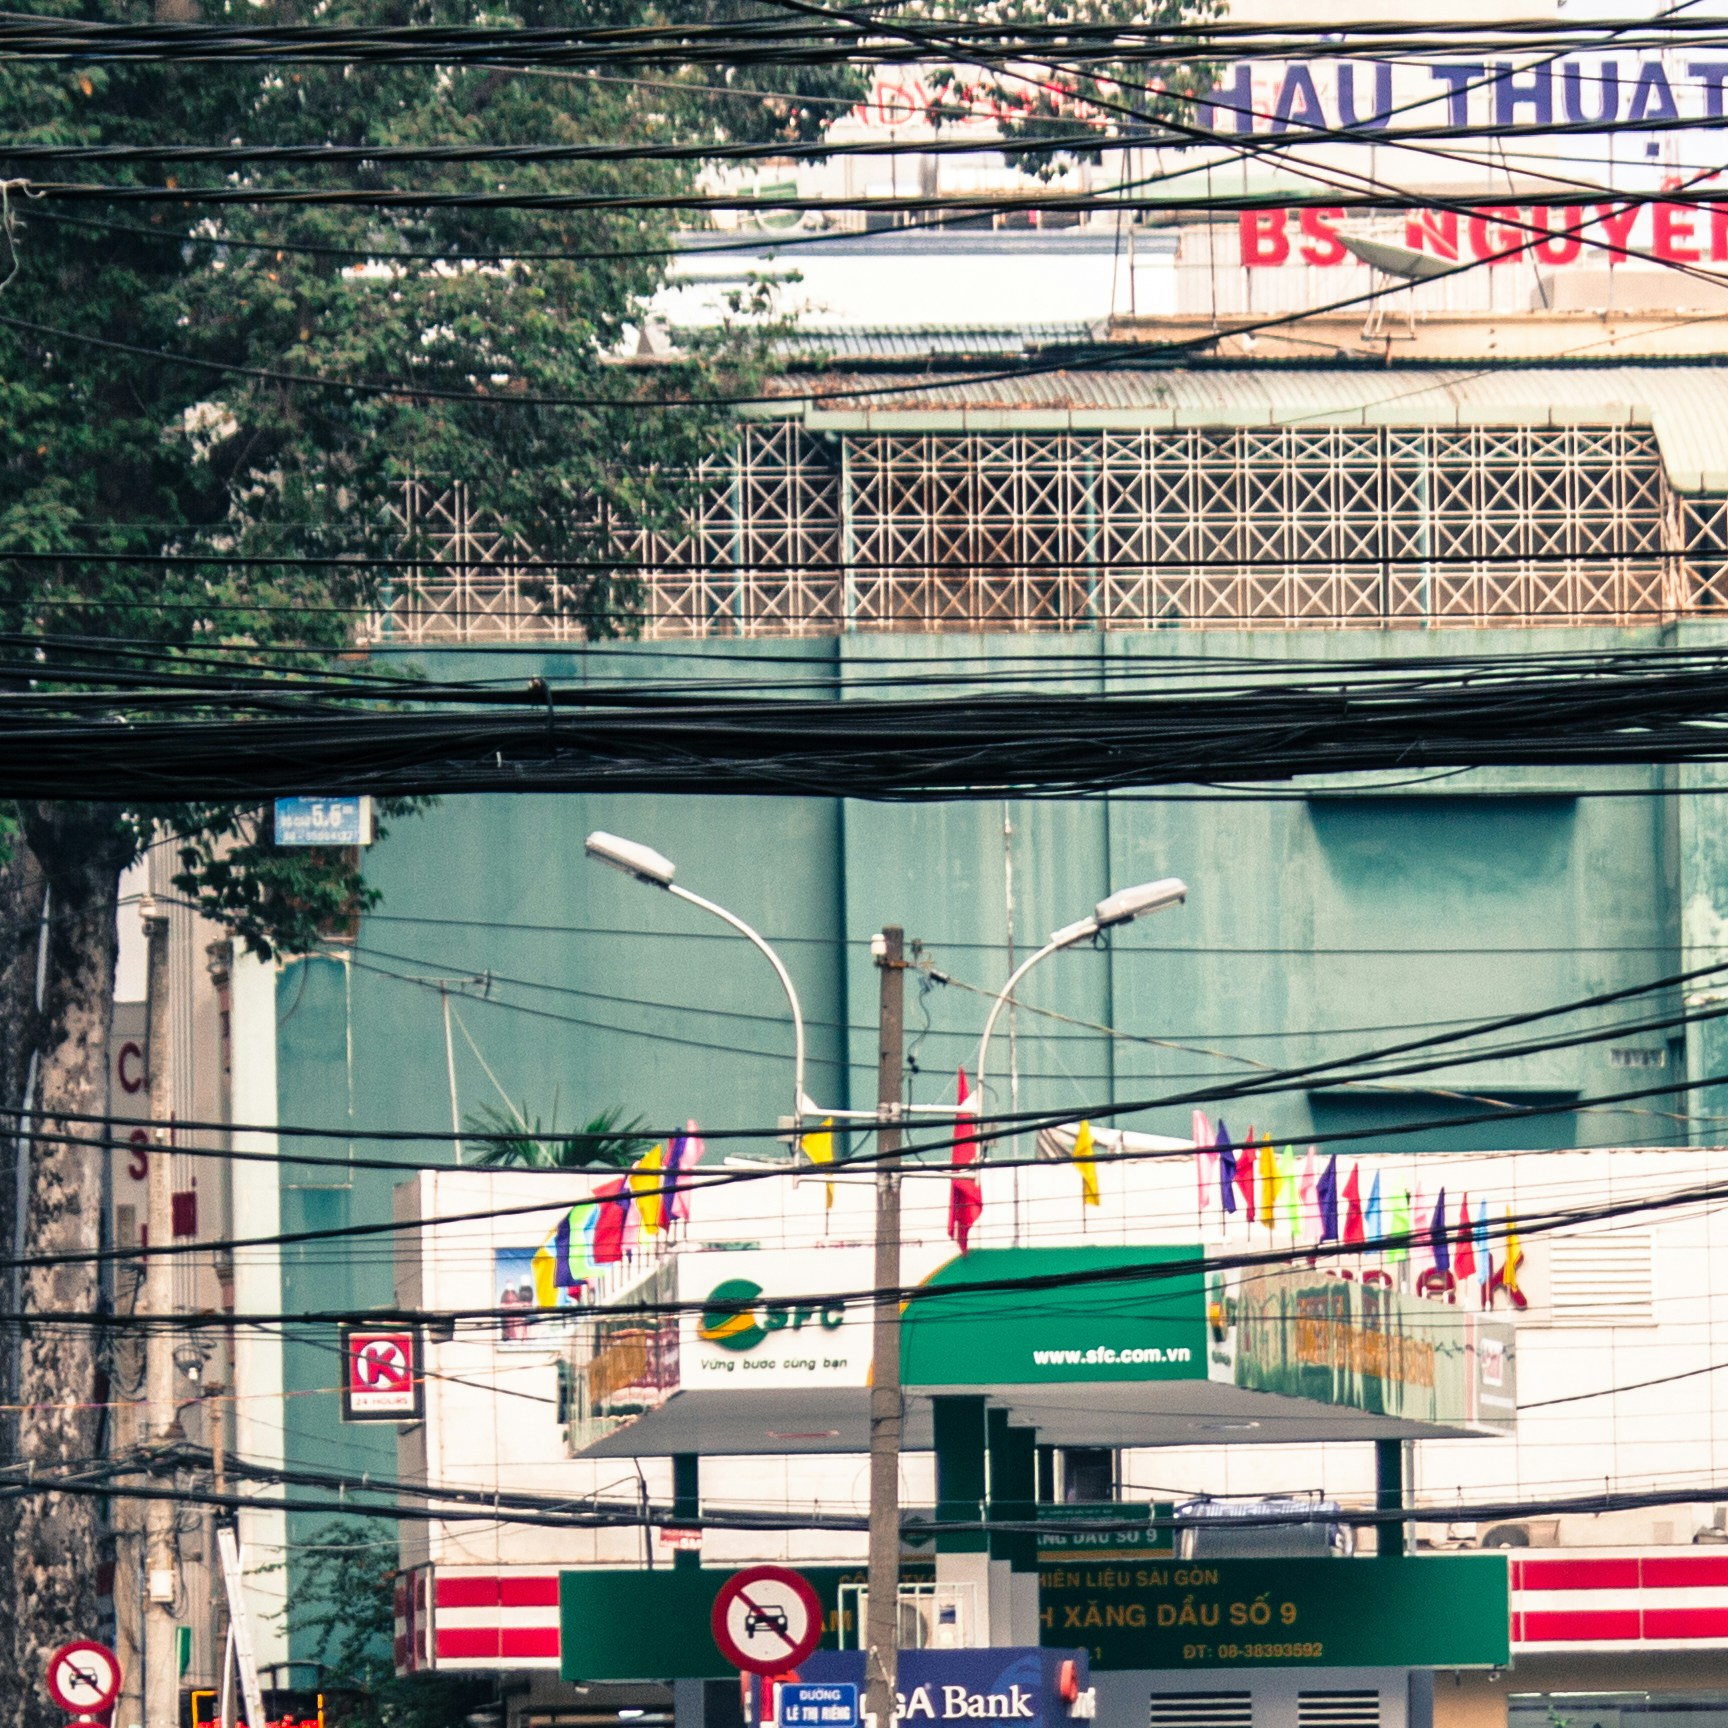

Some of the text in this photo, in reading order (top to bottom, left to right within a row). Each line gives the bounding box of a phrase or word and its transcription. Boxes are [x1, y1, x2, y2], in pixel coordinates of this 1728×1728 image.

[1033, 1345, 1191, 1365] www.sfc.com.vn
[1039, 1568, 1080, 1588] HIÊN
[1065, 1597, 1147, 1628] XĂNG
[1280, 1602, 1297, 1625] 9
[942, 1684, 1034, 1719] Bank
